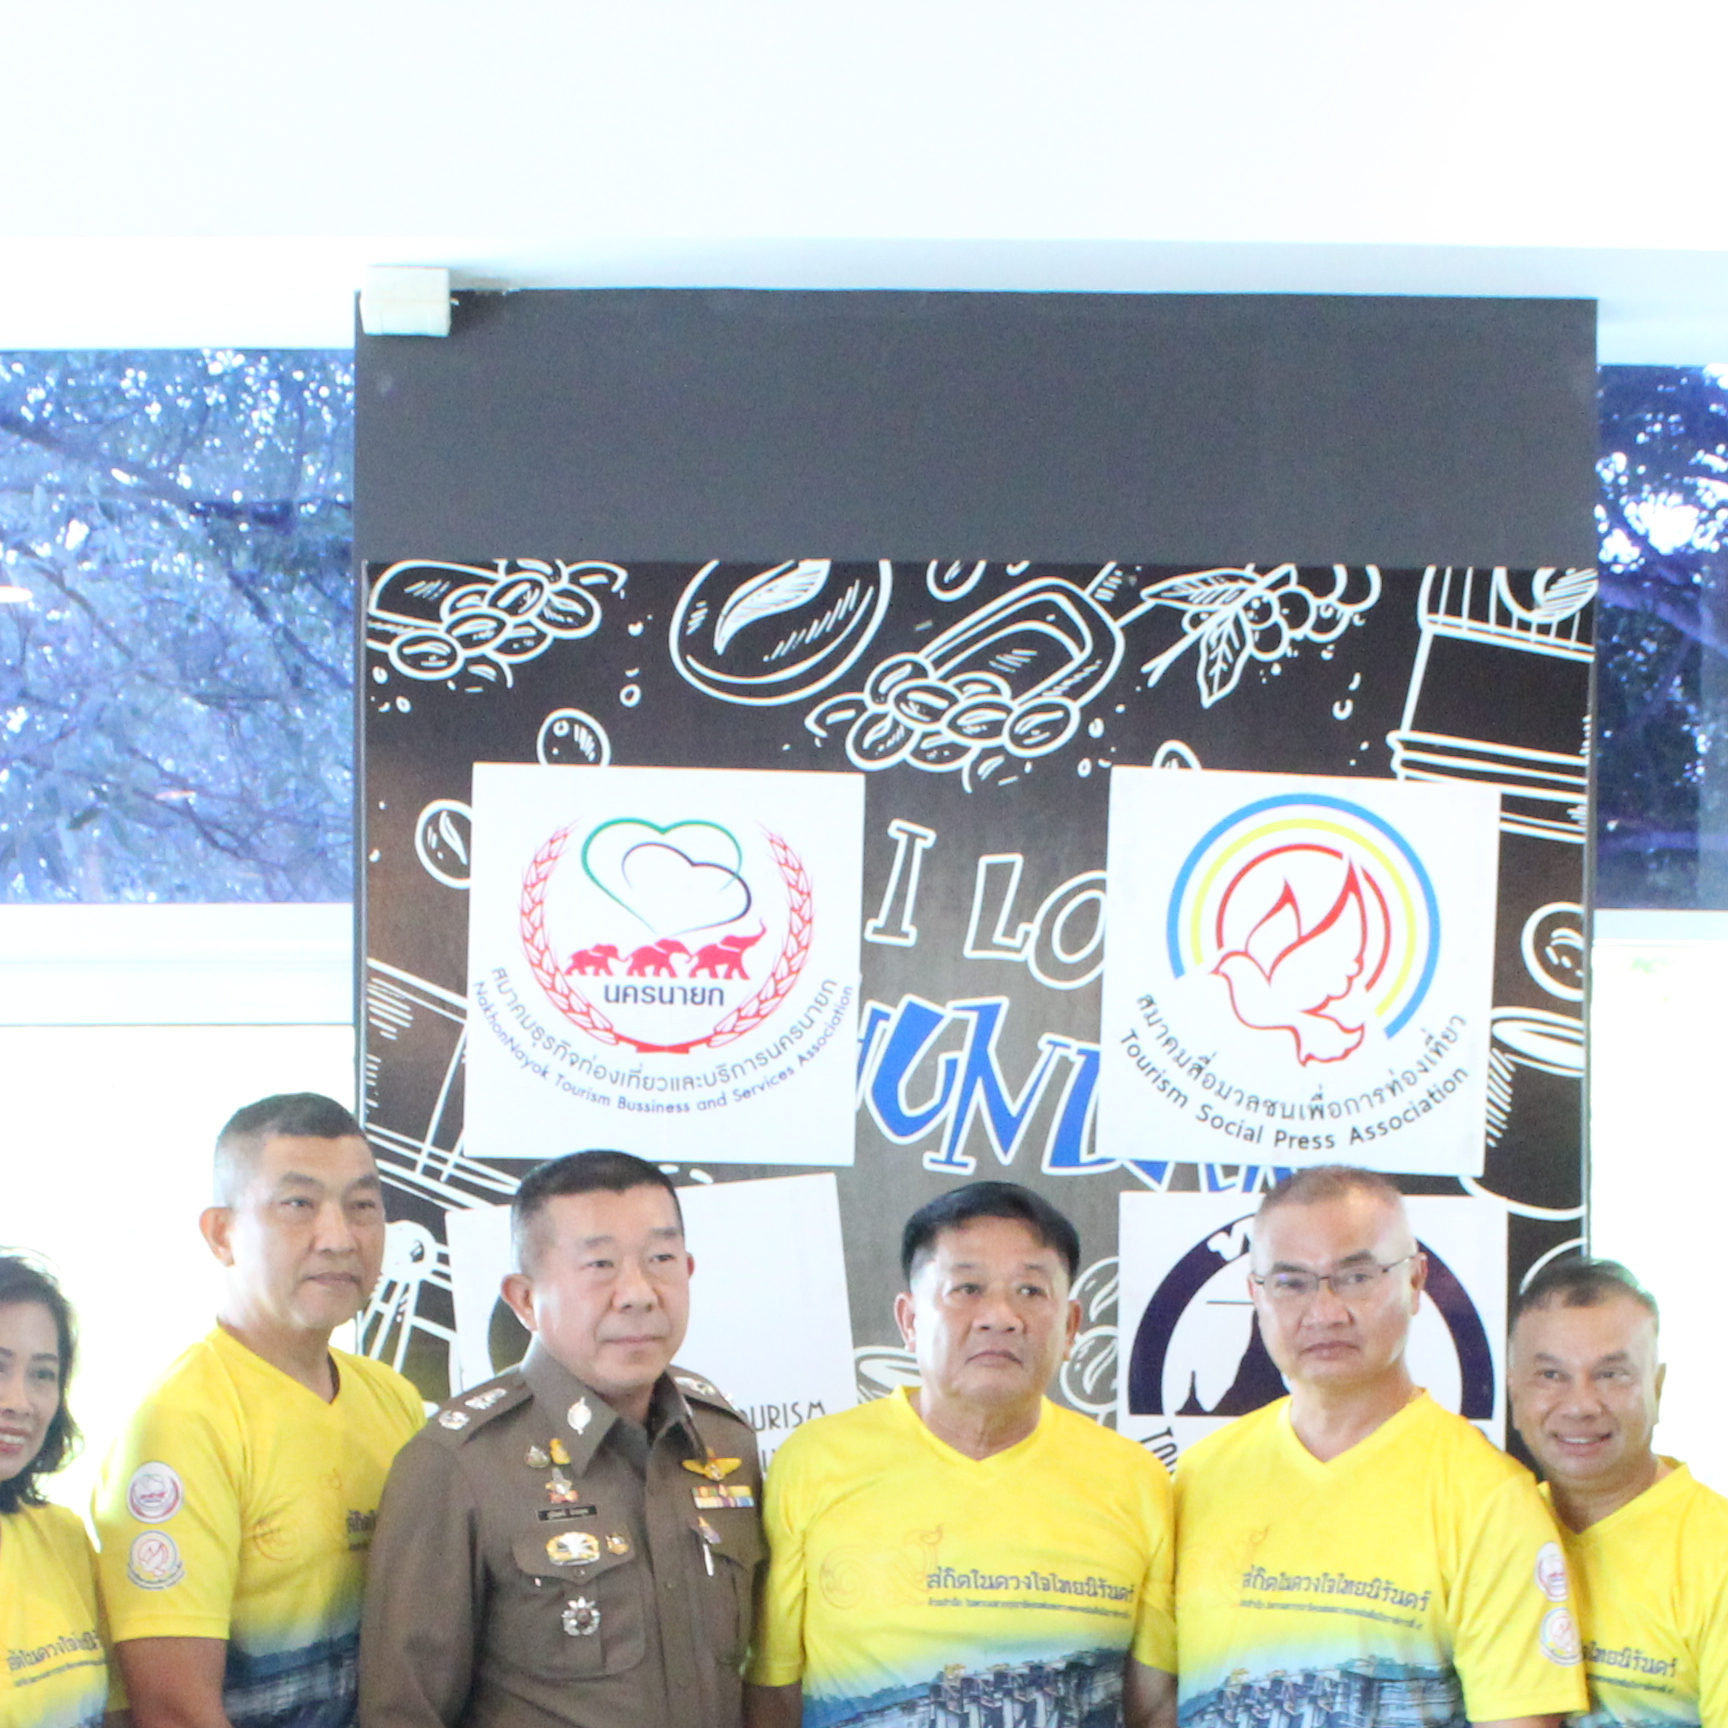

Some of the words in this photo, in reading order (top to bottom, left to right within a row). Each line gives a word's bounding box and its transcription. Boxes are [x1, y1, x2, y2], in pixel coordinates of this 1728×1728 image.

[963, 853, 1109, 990] LO
[555, 1073, 611, 1107] Tourism
[617, 1095, 690, 1114] Bussiness
[697, 1091, 727, 1112] and
[732, 1066, 794, 1103] Services
[797, 985, 853, 1067] Association
[603, 984, 725, 1007] นครนายก
[1136, 994, 1467, 1121] สมาคมสื่อมวลชนเพื่อการท่องเที่ยว
[1121, 1028, 1189, 1109] Tourism
[1195, 1103, 1264, 1144] Social
[1274, 1129, 1335, 1150] Press
[1349, 1067, 1469, 1145] Association
